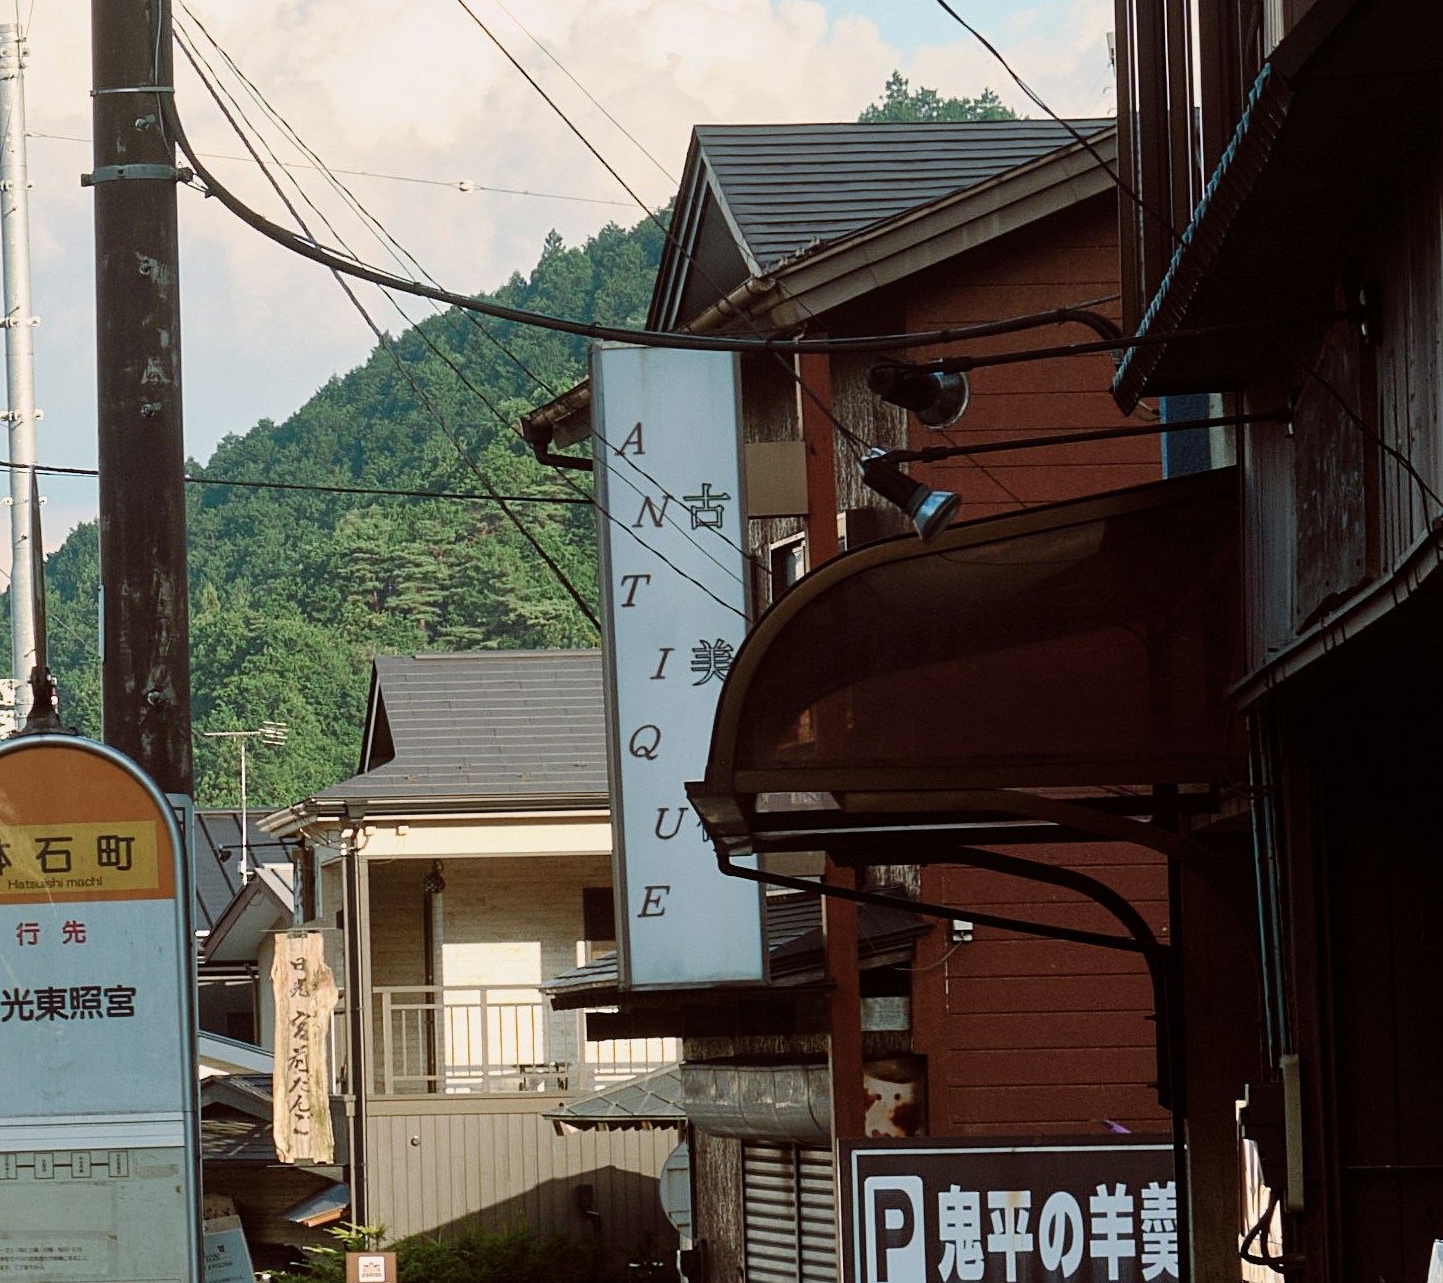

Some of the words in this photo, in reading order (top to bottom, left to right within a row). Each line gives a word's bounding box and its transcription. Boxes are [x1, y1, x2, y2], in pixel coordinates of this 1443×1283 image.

[614, 421, 688, 919] ANTIQUE
[66, 876, 103, 888] machi
[15, 920, 87, 947] 行先
[876, 1186, 915, 1283] P
